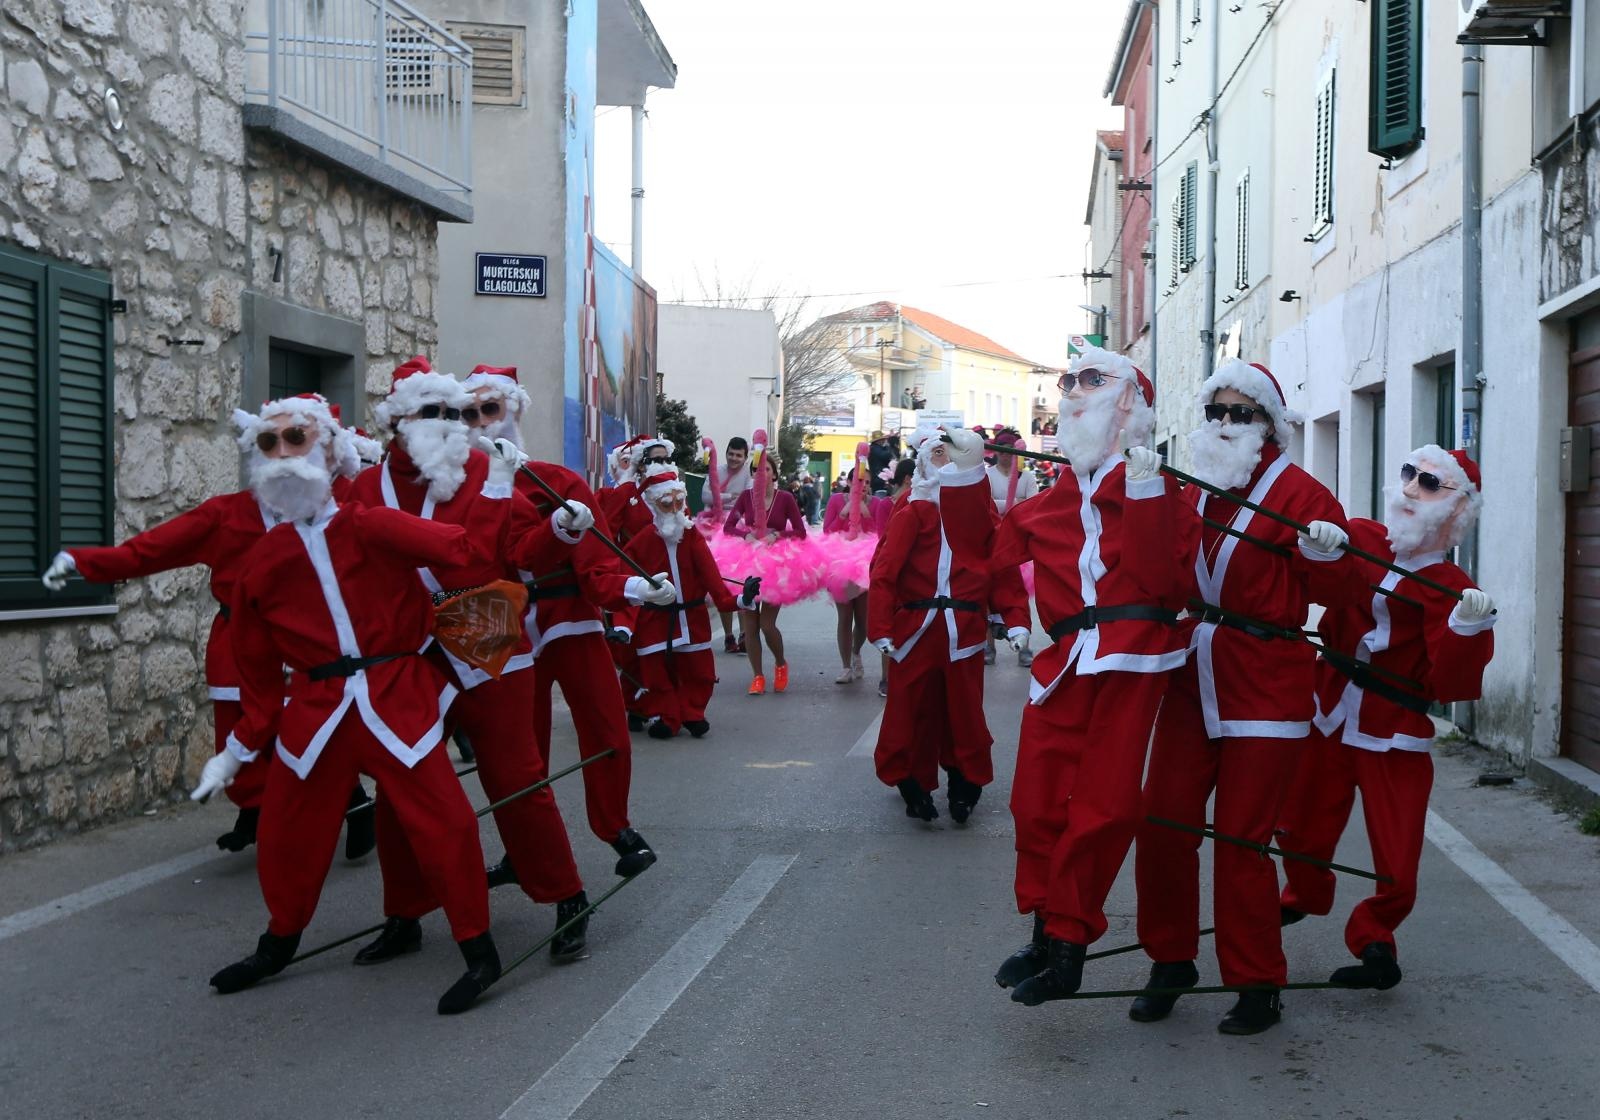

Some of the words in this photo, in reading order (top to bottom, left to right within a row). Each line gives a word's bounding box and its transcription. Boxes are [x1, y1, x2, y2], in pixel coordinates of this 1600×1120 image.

[269, 247, 282, 282] 7
[483, 266, 540, 280] MURTERSKIH
[484, 280, 538, 294] GLAGOLJAŠA
